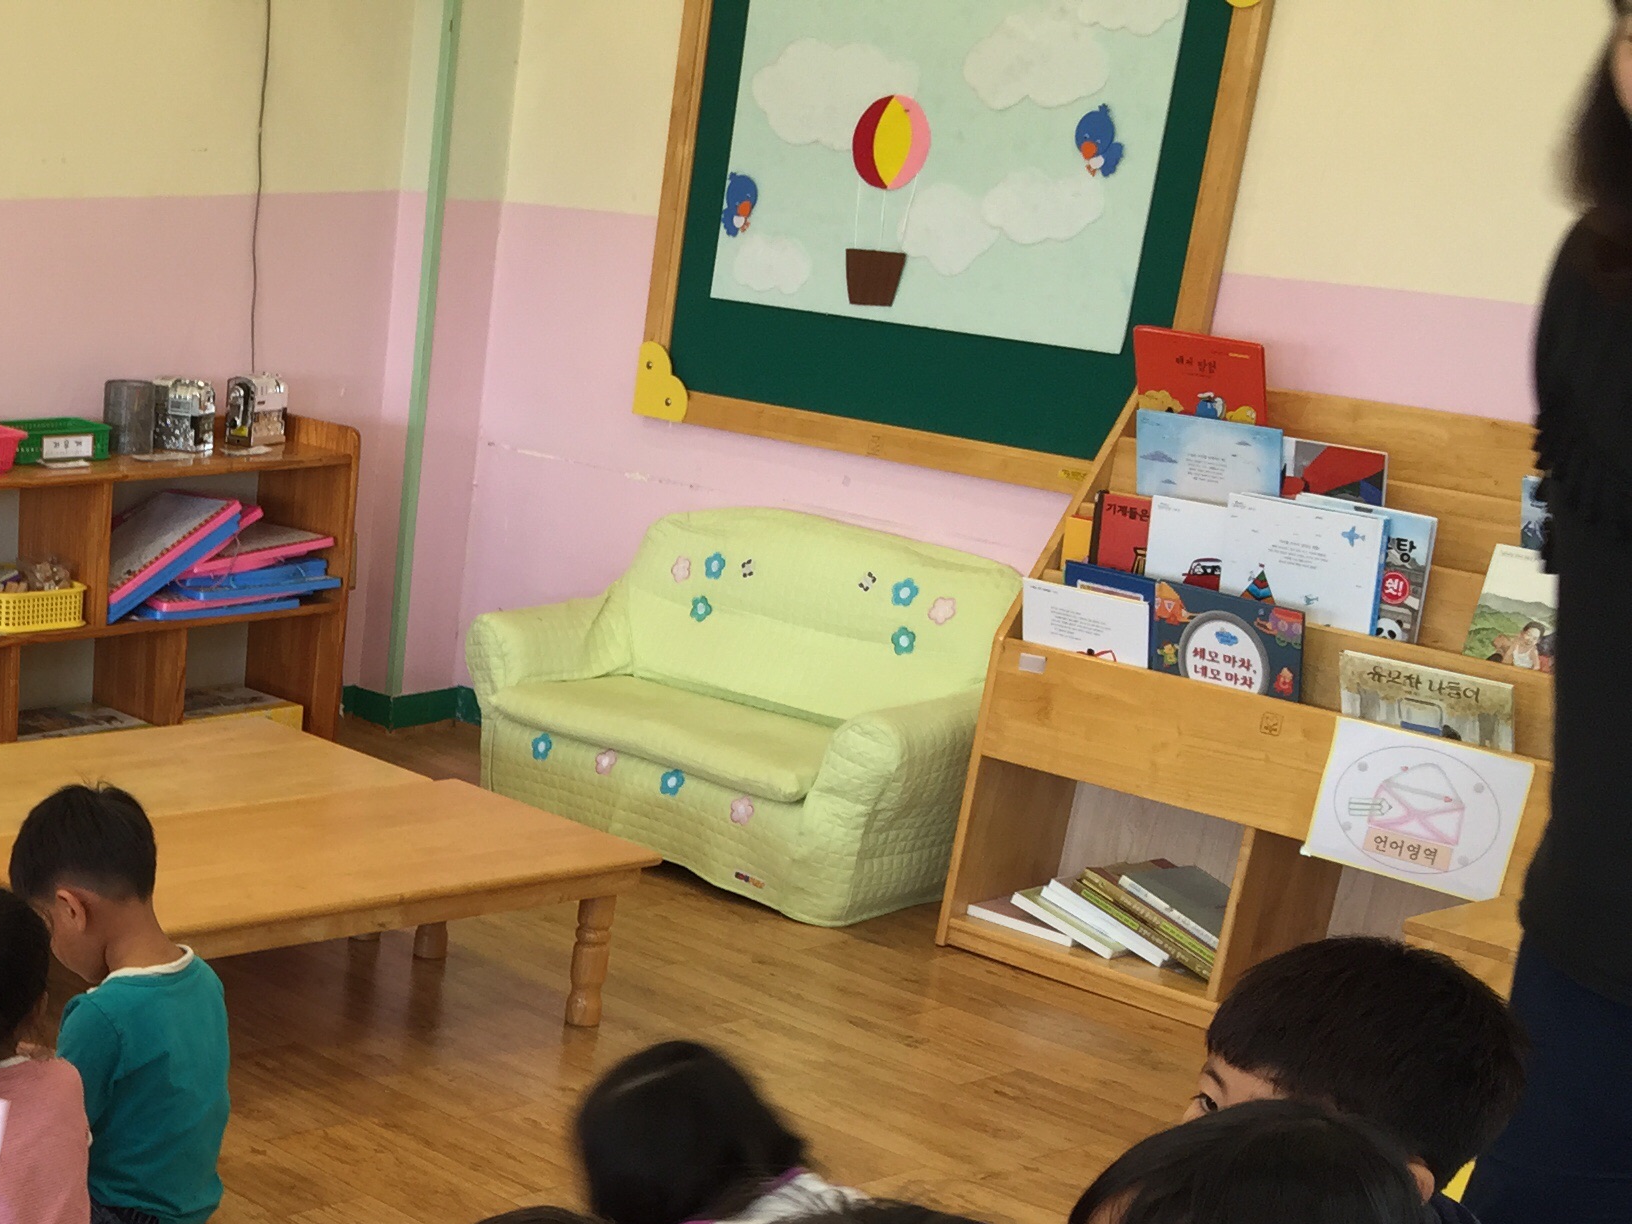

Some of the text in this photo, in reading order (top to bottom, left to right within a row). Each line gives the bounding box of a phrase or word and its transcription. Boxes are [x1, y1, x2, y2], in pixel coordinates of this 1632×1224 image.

[1385, 577, 1404, 597] 쉿!
[1192, 646, 1257, 675] 세모 마차,
[1193, 664, 1254, 689] 네모 마차
[1367, 665, 1422, 690] 유모차
[1373, 835, 1438, 866] 언어영역
